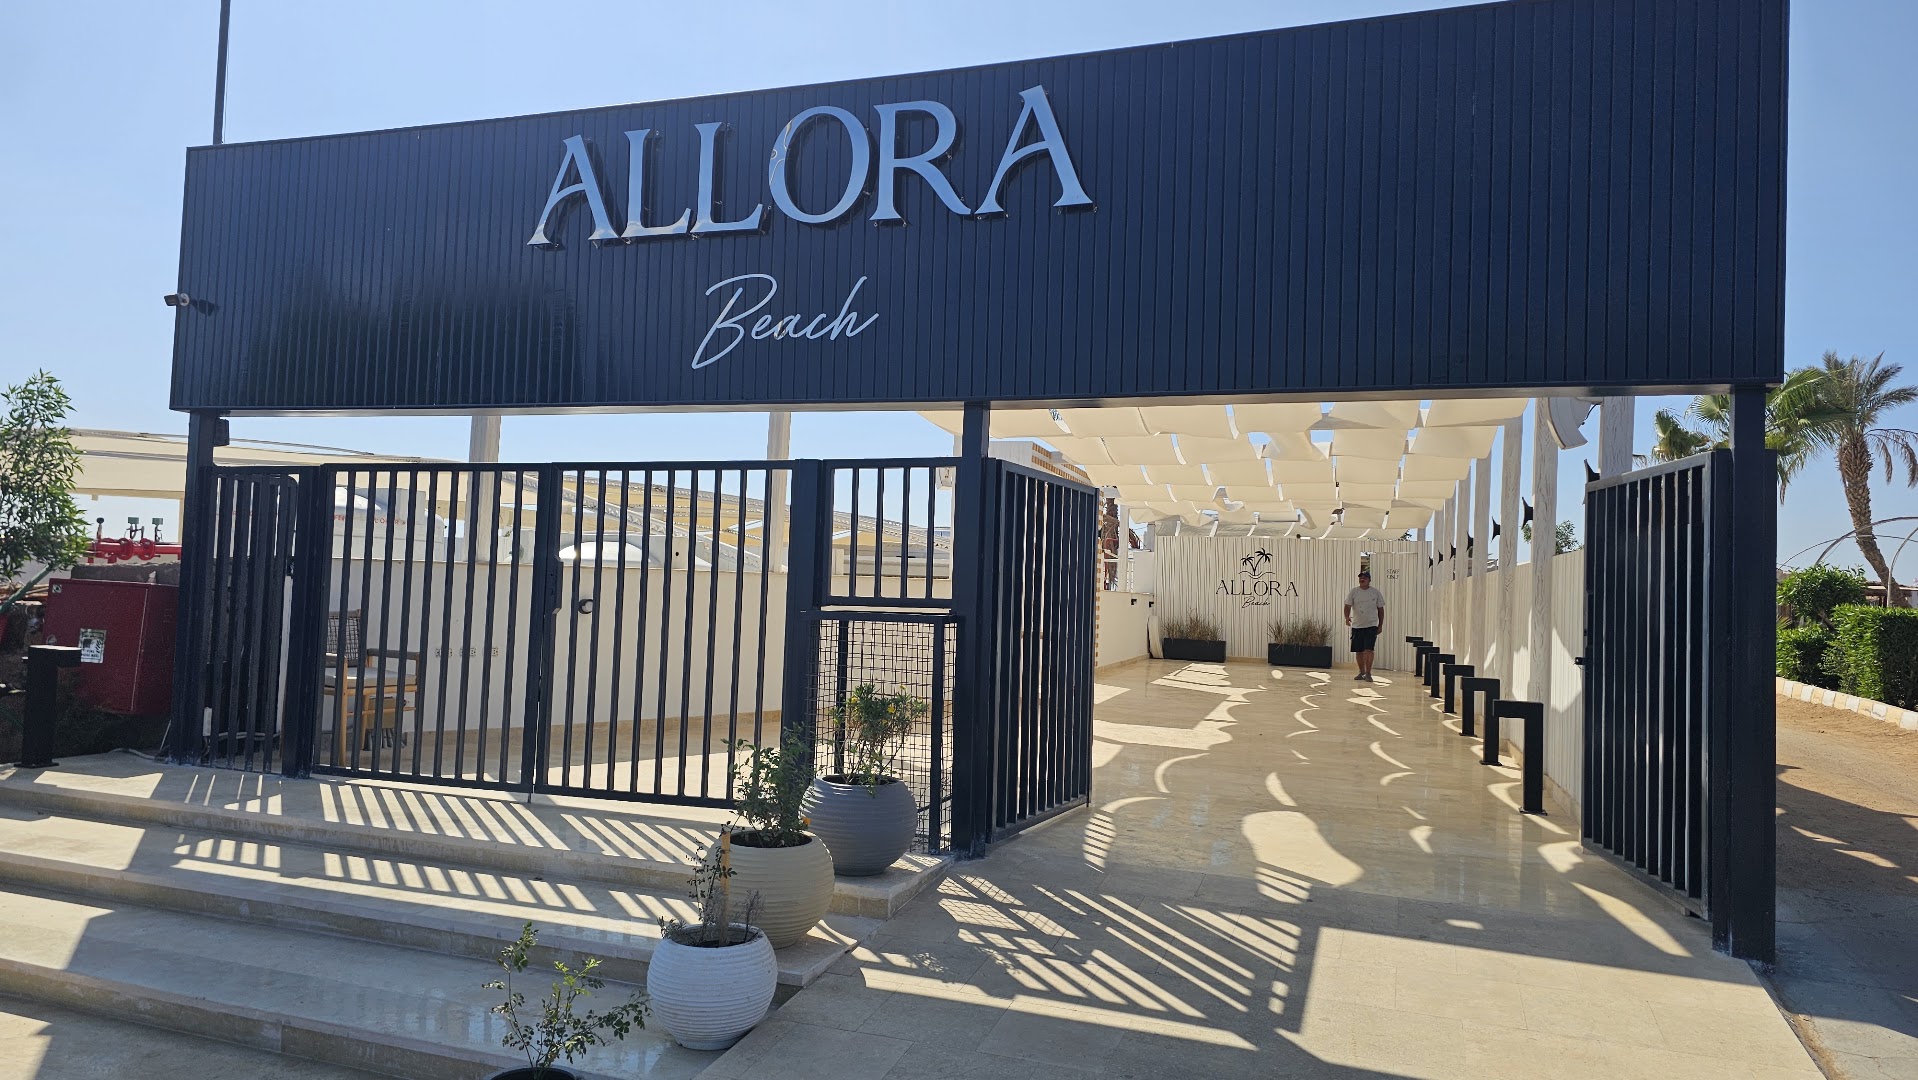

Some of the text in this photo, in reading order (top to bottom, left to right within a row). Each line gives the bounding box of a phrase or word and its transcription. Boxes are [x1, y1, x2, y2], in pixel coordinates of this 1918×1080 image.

[526, 84, 1094, 246] ALLORA
[690, 272, 880, 370] Beach
[1215, 579, 1299, 597] ALLORA
[1241, 595, 1271, 609] Beach
